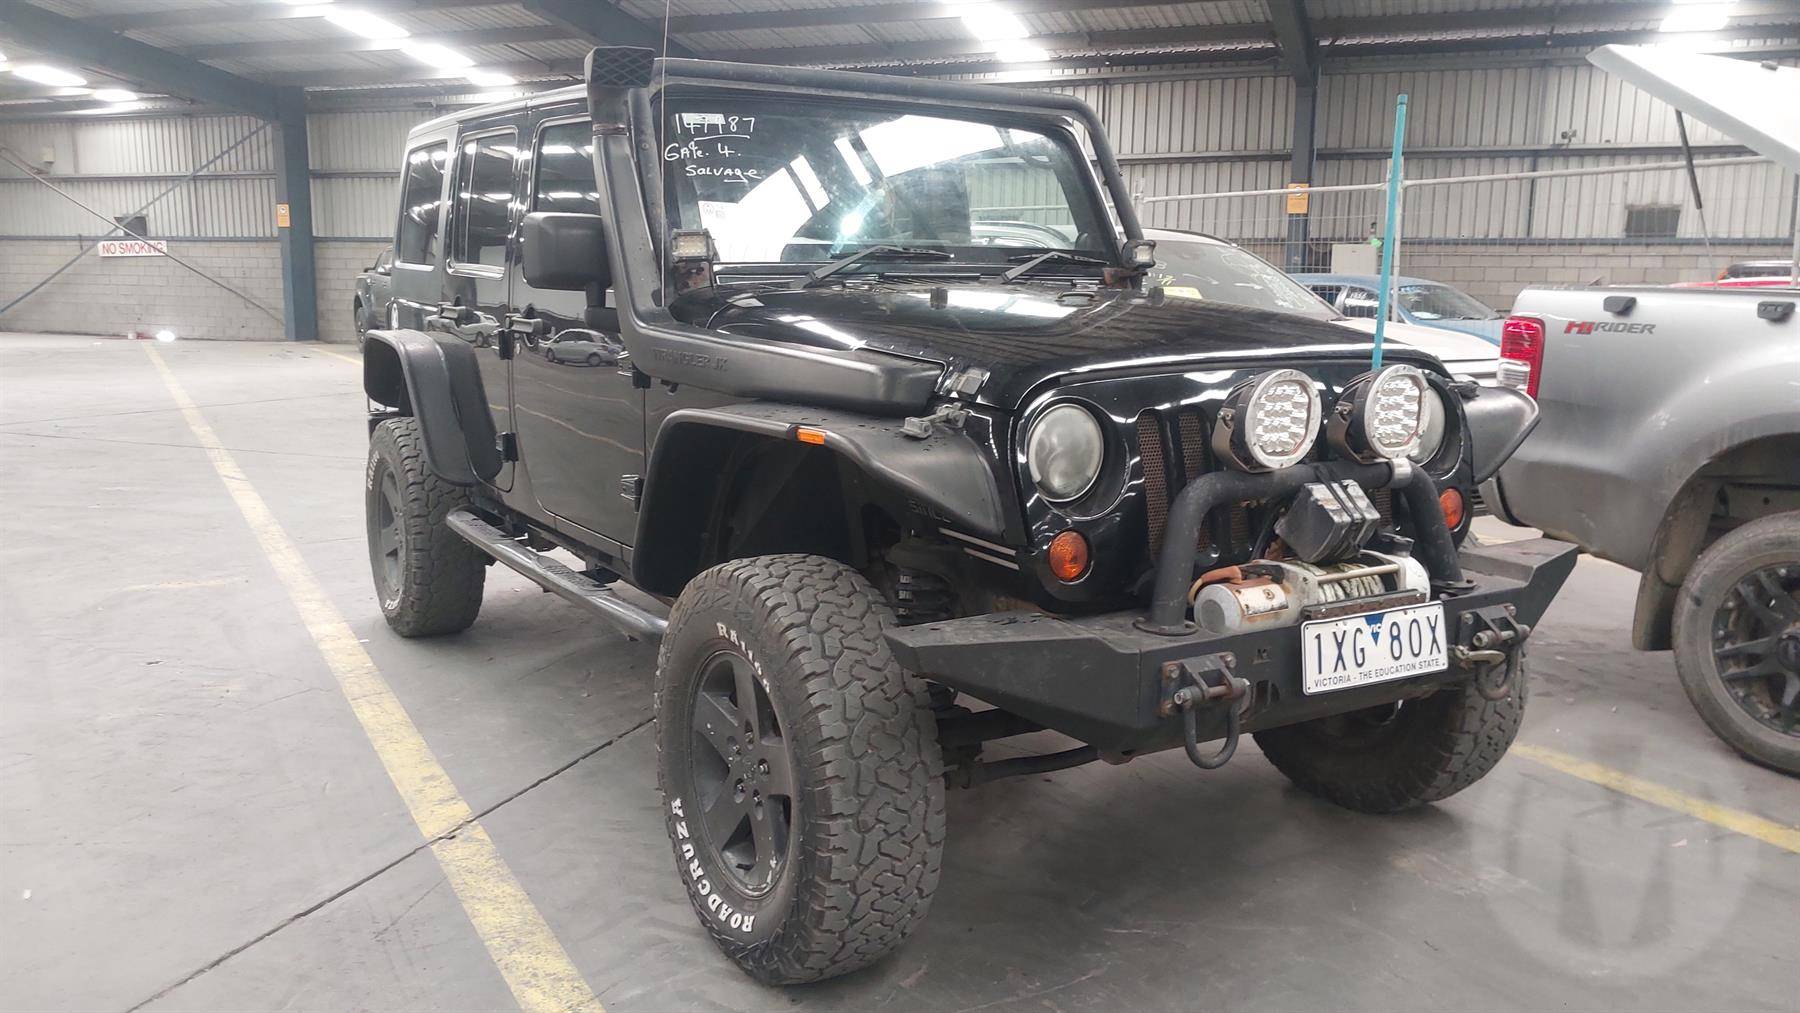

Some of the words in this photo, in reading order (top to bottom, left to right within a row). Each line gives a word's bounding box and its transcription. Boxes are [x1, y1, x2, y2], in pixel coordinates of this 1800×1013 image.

[102, 242, 117, 255] NO
[119, 242, 163, 254] SMOKING
[1314, 627, 1366, 675] 1XG
[1389, 614, 1442, 661] 80X
[1314, 674, 1352, 688] VICTORIA
[1359, 670, 1373, 680] THE
[1374, 663, 1417, 678] EDUCATION
[1418, 657, 1440, 670] STATE
[670, 797, 757, 933] ROADCRUZA
